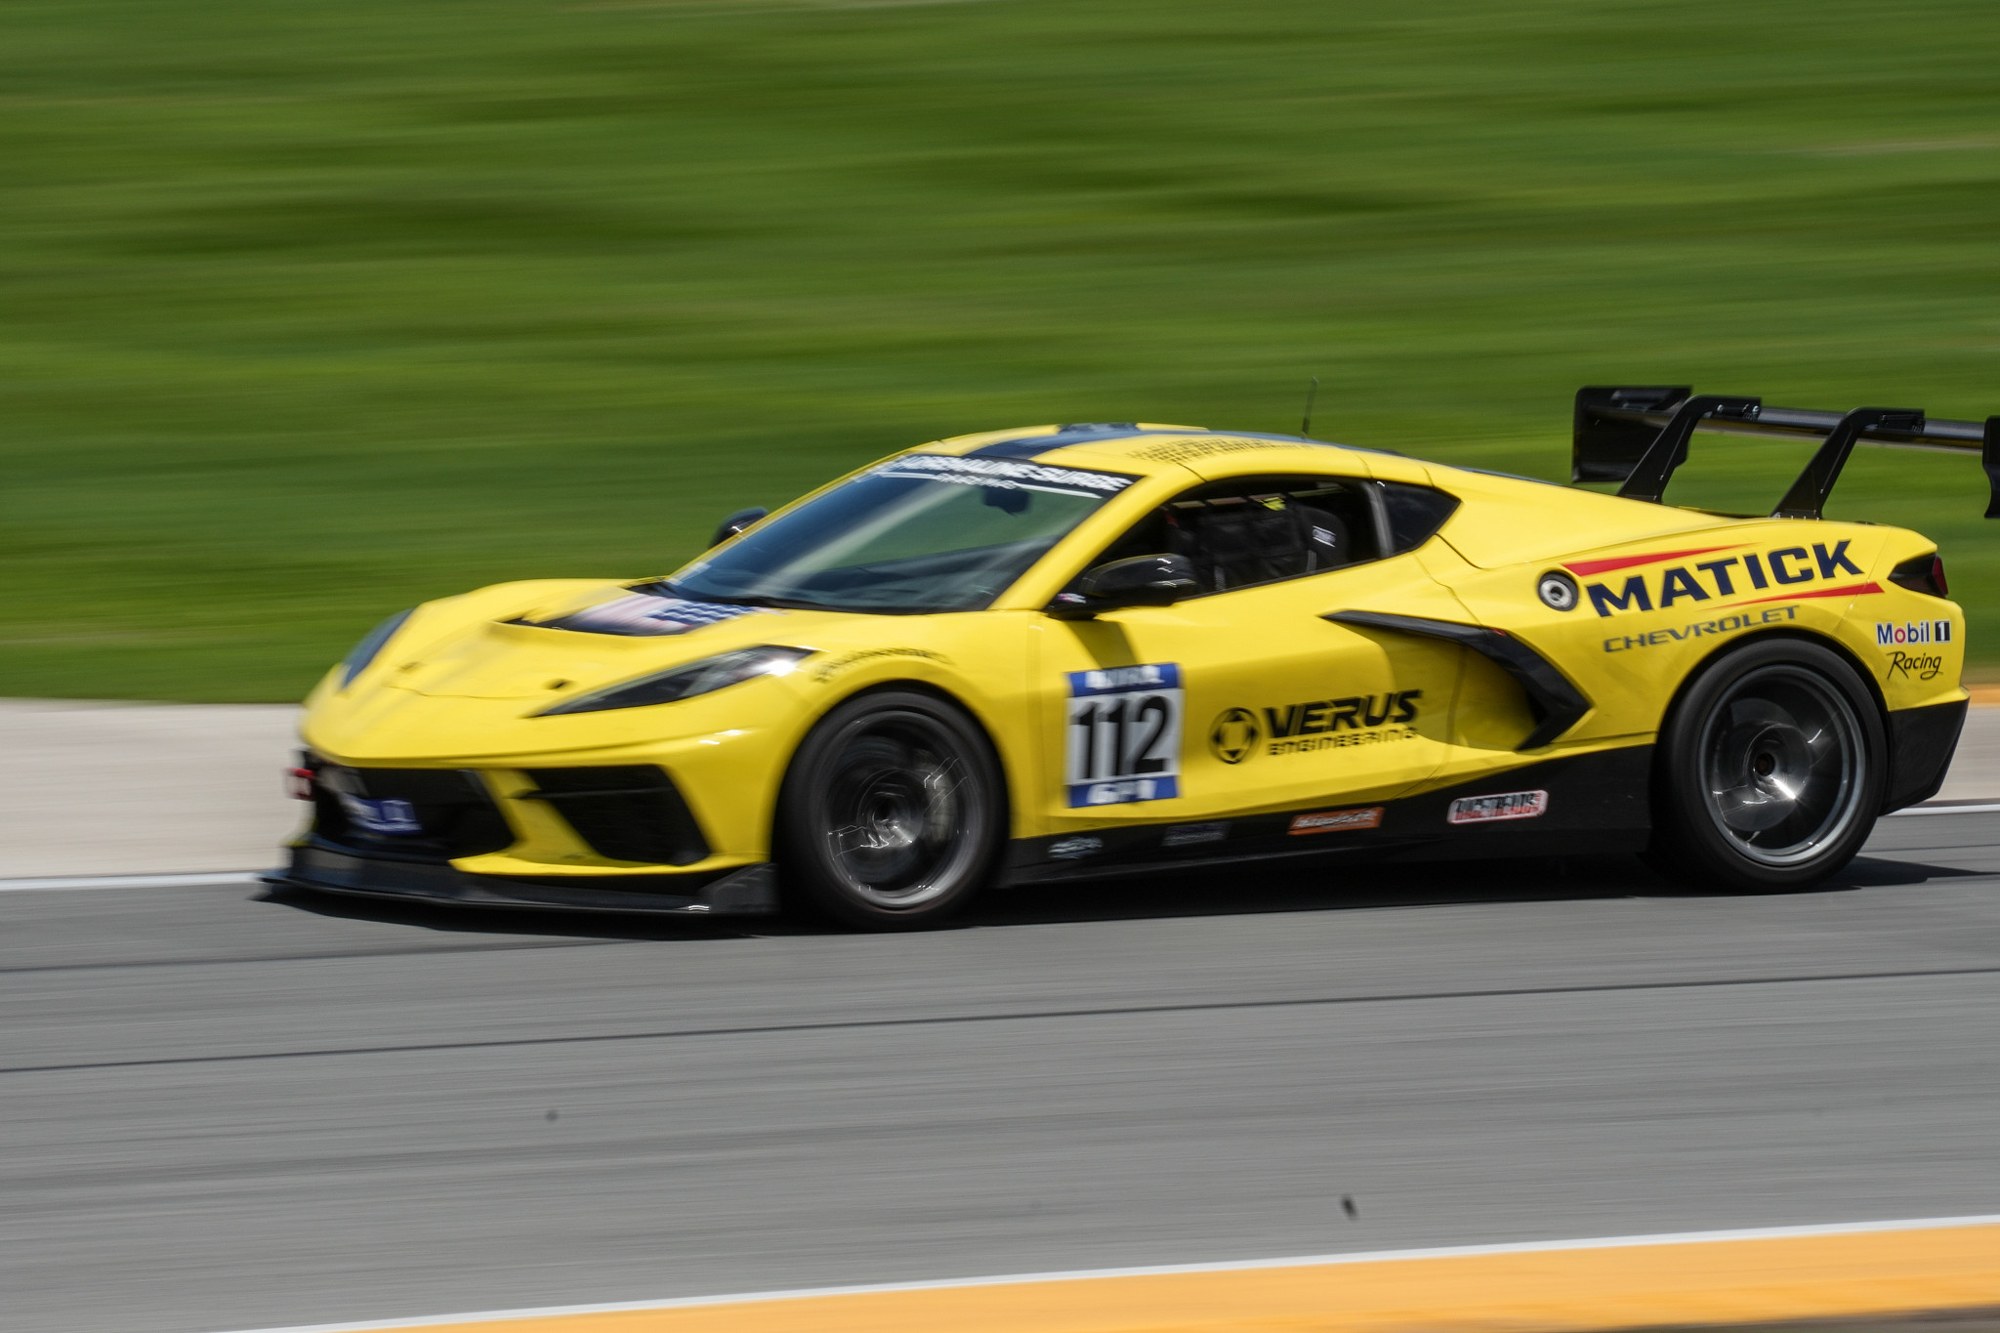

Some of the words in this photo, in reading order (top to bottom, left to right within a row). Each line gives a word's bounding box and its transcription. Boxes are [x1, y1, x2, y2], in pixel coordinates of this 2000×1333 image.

[1584, 538, 1866, 618] MATICK
[1603, 605, 1800, 653] CHEVROLET
[1877, 622, 1930, 645] Mobil
[1935, 620, 1950, 642] 1
[1886, 650, 1944, 681] Racing
[1262, 688, 1423, 738] VERUS
[1070, 695, 1170, 780] 112
[1267, 727, 1418, 756] ENGINEERING
